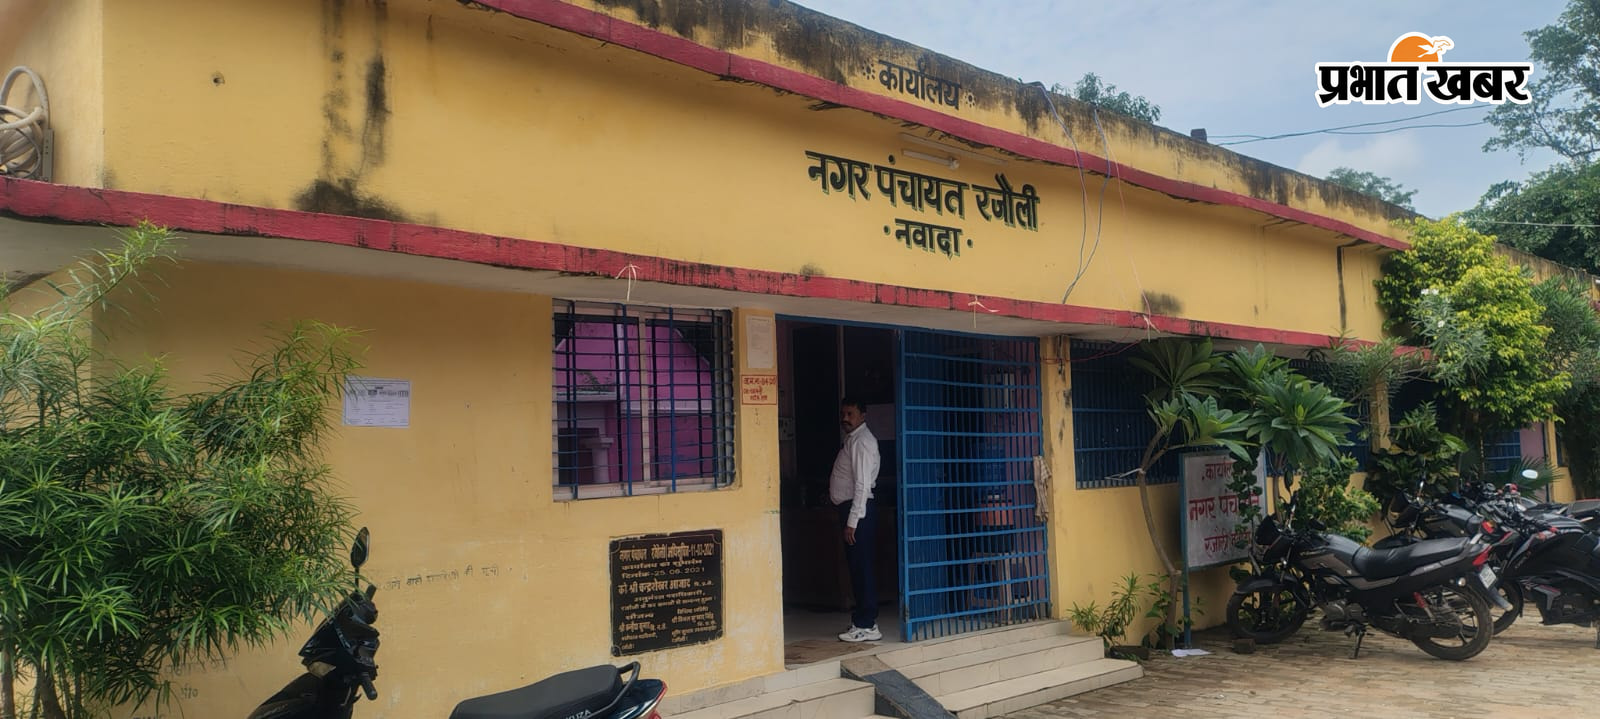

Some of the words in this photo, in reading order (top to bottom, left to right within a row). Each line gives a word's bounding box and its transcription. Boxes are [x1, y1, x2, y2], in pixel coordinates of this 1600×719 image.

[878, 58, 960, 110] कार्यालय
[805, 150, 872, 201] नगर
[874, 154, 970, 219] पंचायत
[971, 172, 1040, 232] रजौली
[894, 218, 962, 259] नवादा
[1189, 497, 1217, 521] नगर
